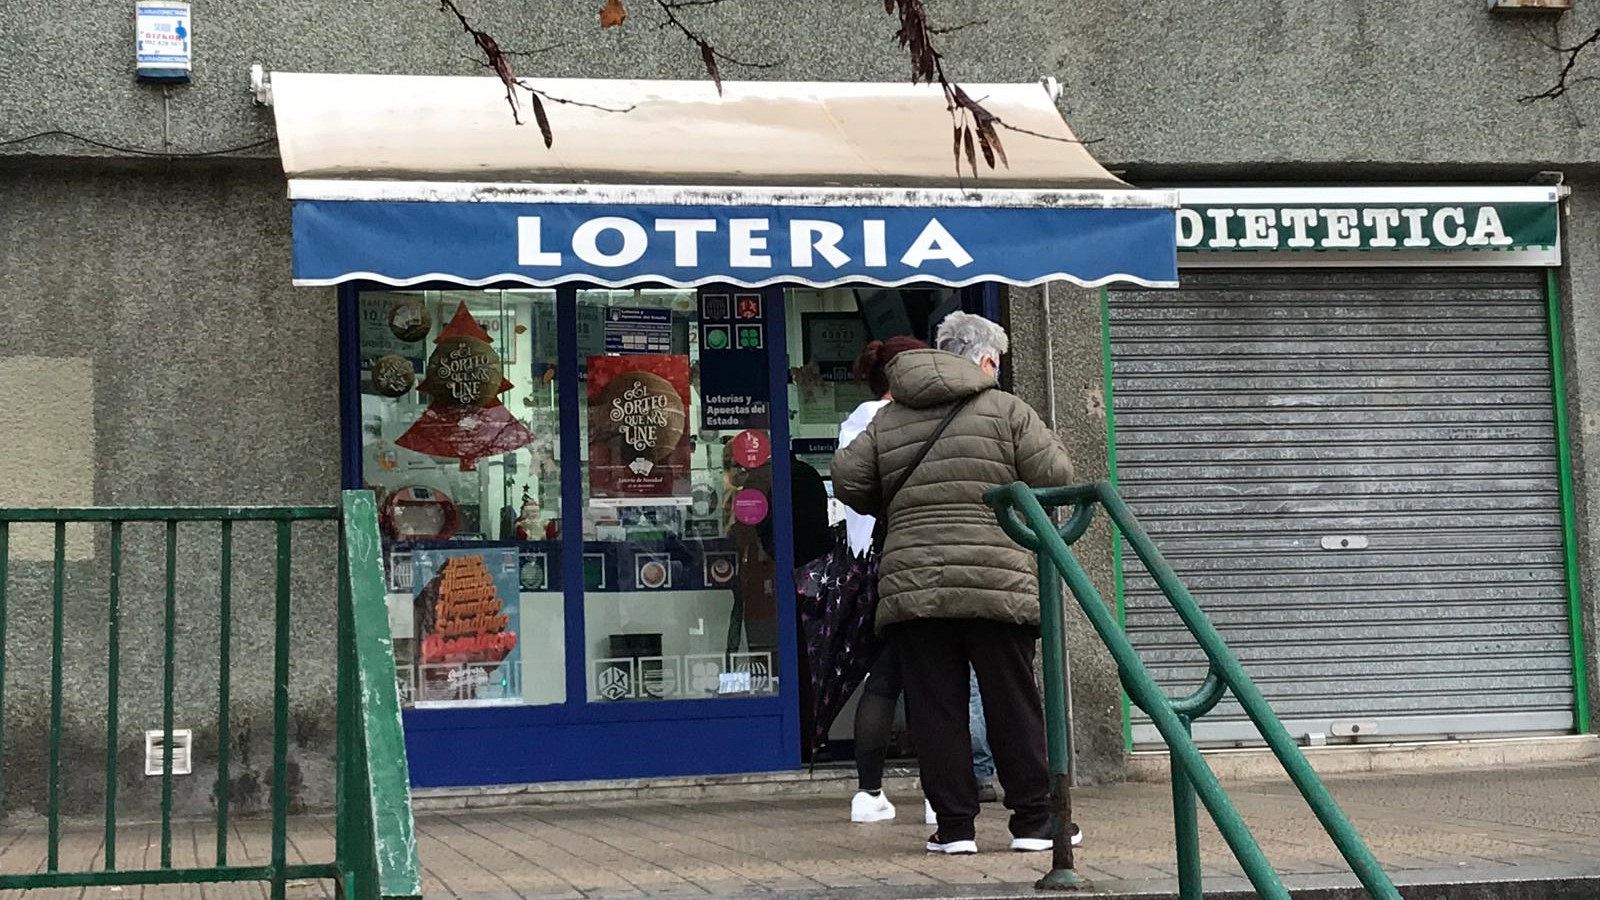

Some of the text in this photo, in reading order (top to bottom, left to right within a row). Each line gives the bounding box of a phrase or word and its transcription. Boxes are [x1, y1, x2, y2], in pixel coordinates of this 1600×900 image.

[1176, 206, 1513, 247] DIETETICA
[517, 216, 974, 268] LOTERIA
[446, 380, 481, 404] UNE
[746, 395, 752, 405] y
[610, 394, 668, 422] SORTEO
[707, 403, 765, 416] Apuestas del
[707, 416, 738, 425] Estado
[619, 424, 657, 451] UNE
